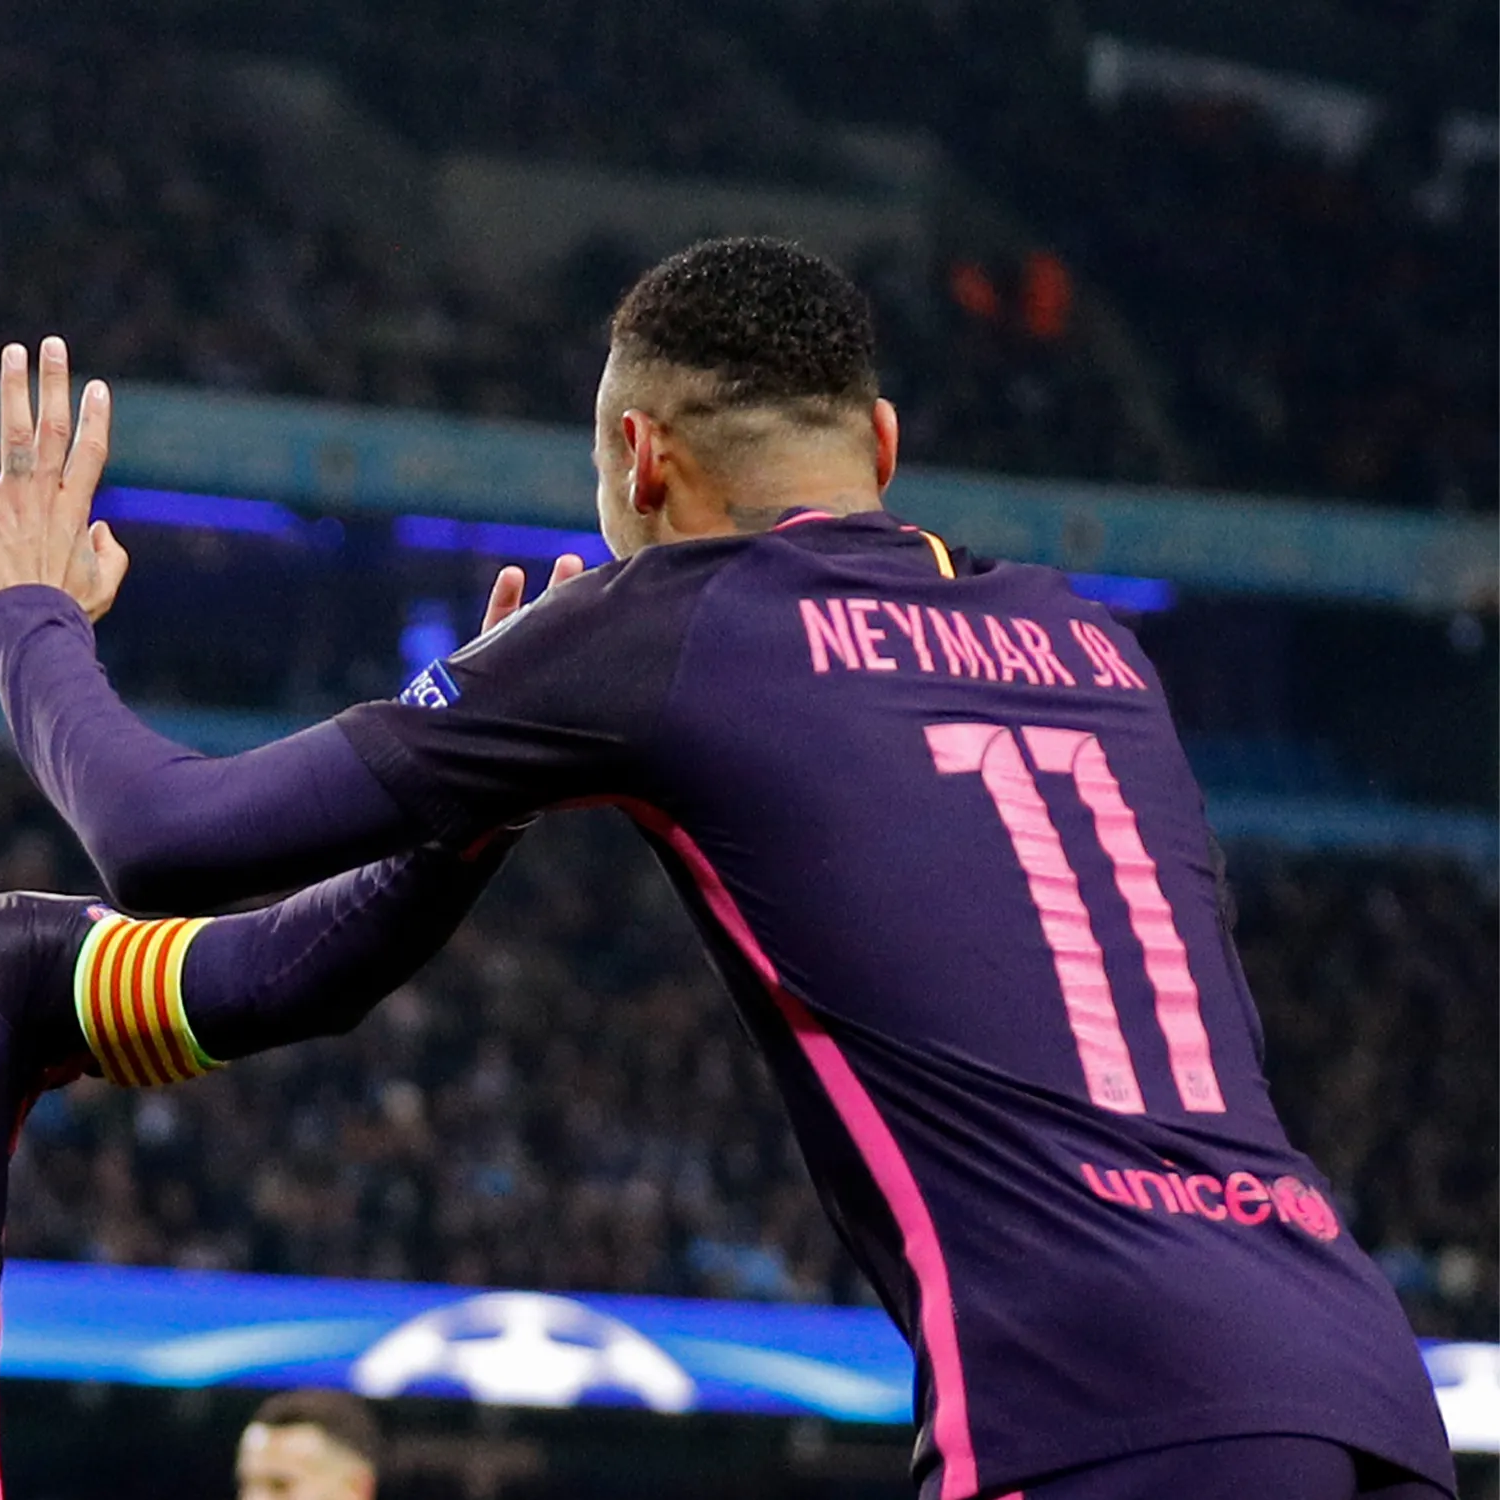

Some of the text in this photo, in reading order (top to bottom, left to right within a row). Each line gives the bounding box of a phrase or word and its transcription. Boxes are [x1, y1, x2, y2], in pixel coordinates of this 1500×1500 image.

[799, 598, 1148, 690] NEYMAR JR
[923, 722, 1225, 1114] 11
